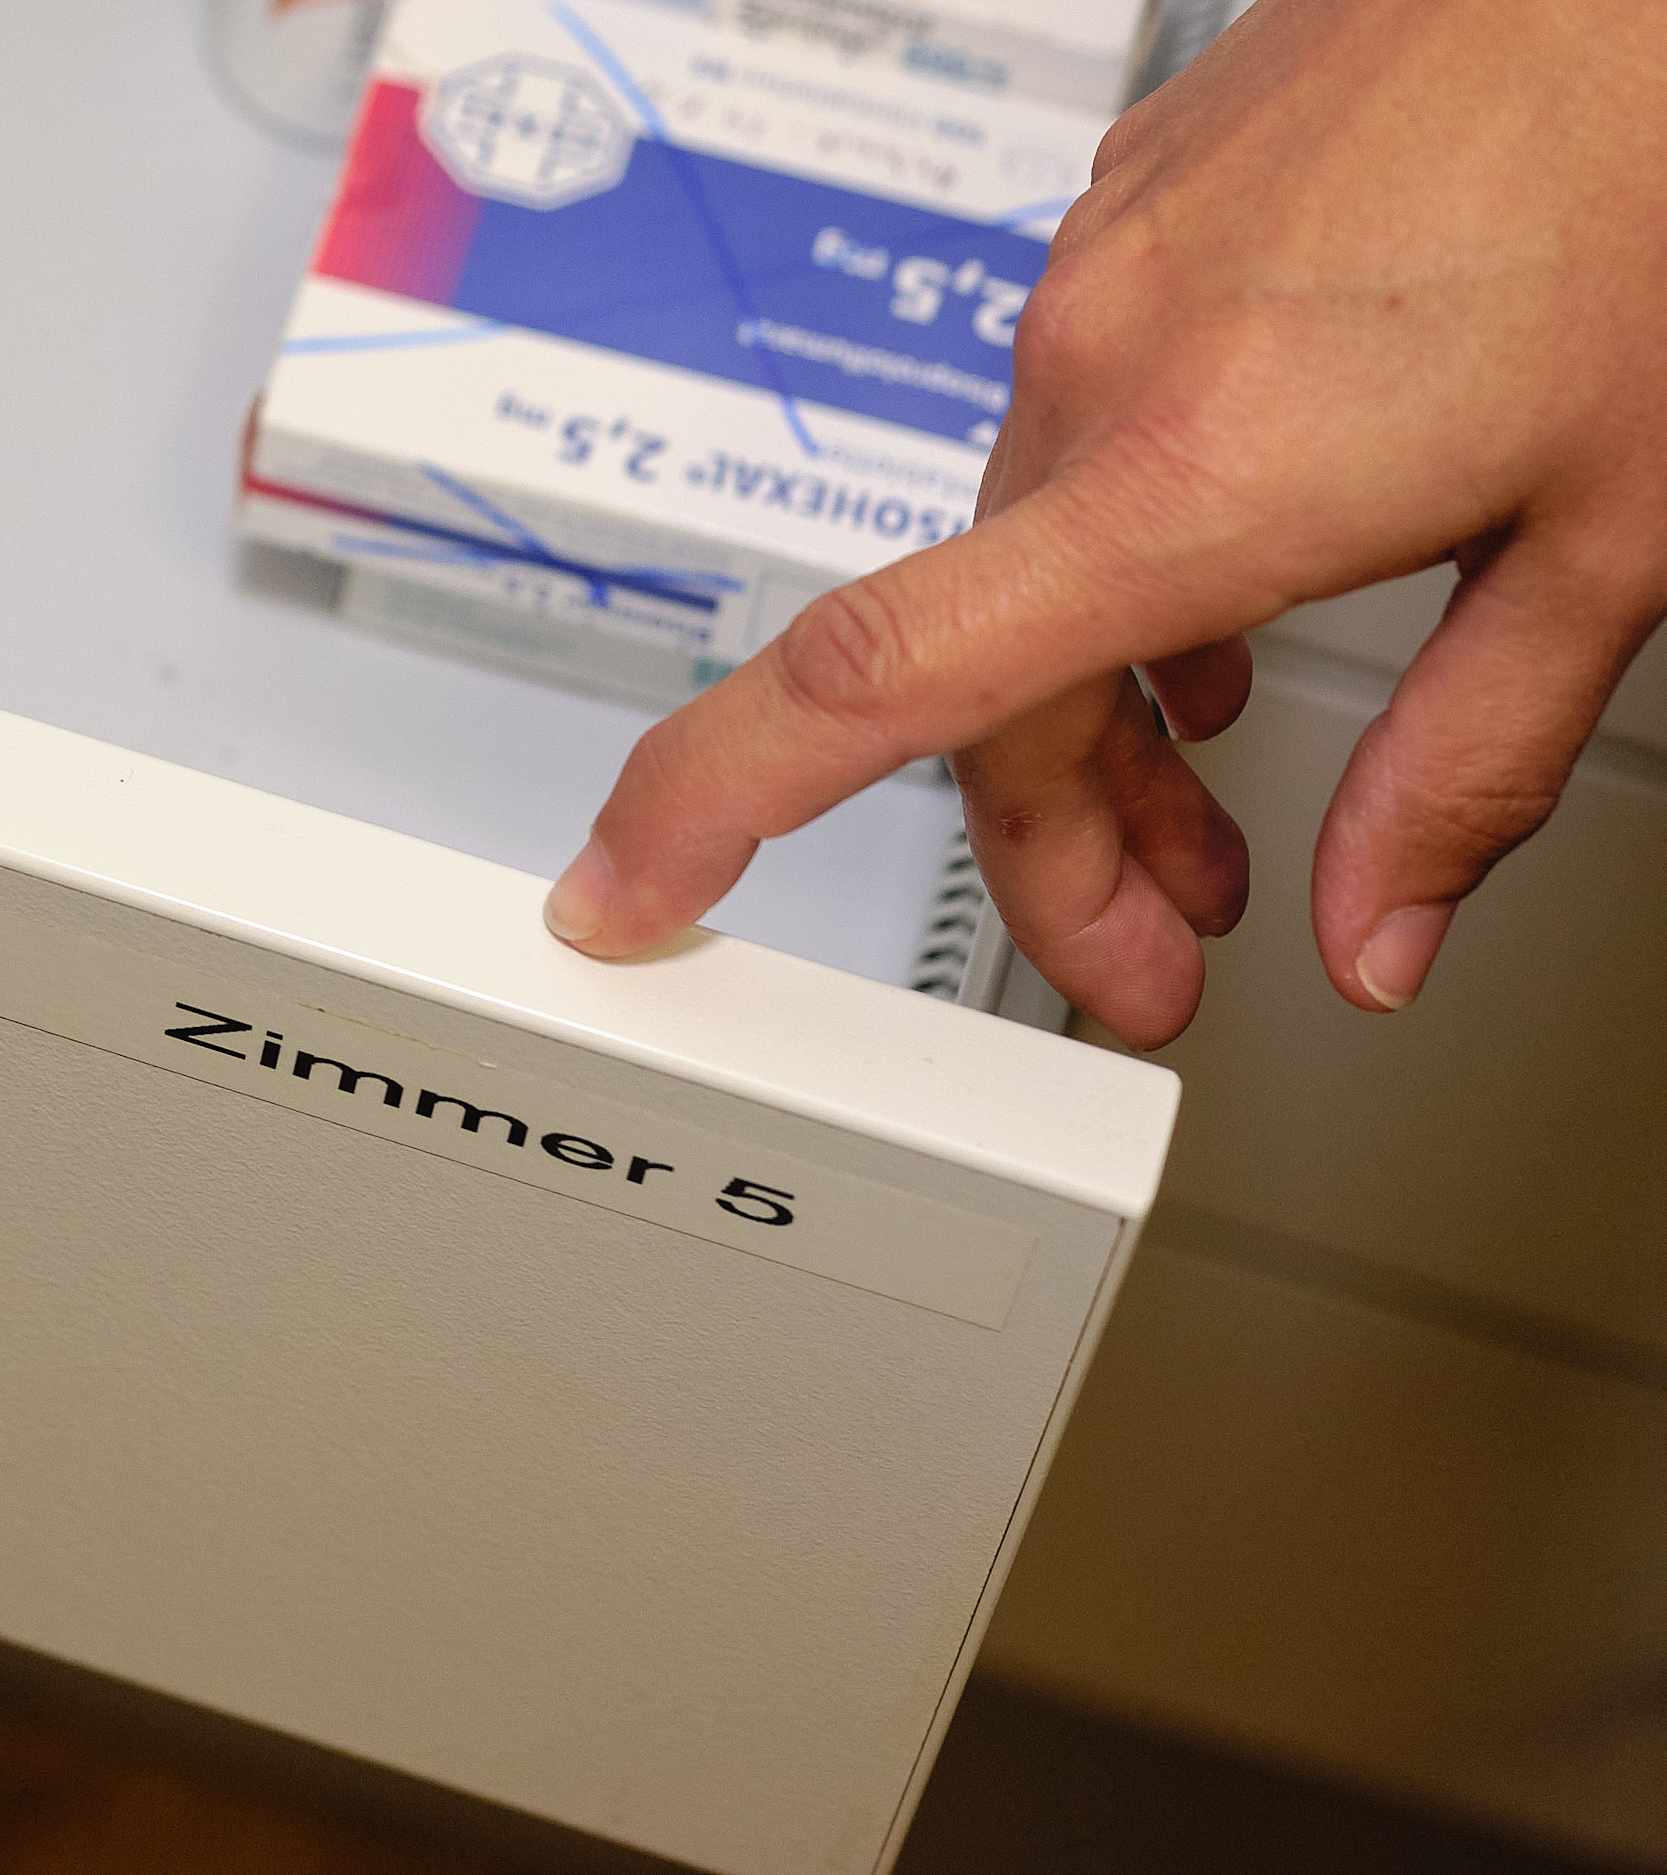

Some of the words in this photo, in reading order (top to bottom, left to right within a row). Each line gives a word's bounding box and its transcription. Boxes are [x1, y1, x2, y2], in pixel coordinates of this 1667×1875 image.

[811, 225, 890, 283] mg
[889, 238, 1029, 350] 2,5
[494, 389, 553, 429] mg
[556, 416, 667, 485] 2,5
[684, 450, 971, 547] ISOHEXAL®
[164, 1001, 674, 1186] Zimmer
[715, 1178, 795, 1227] 5
